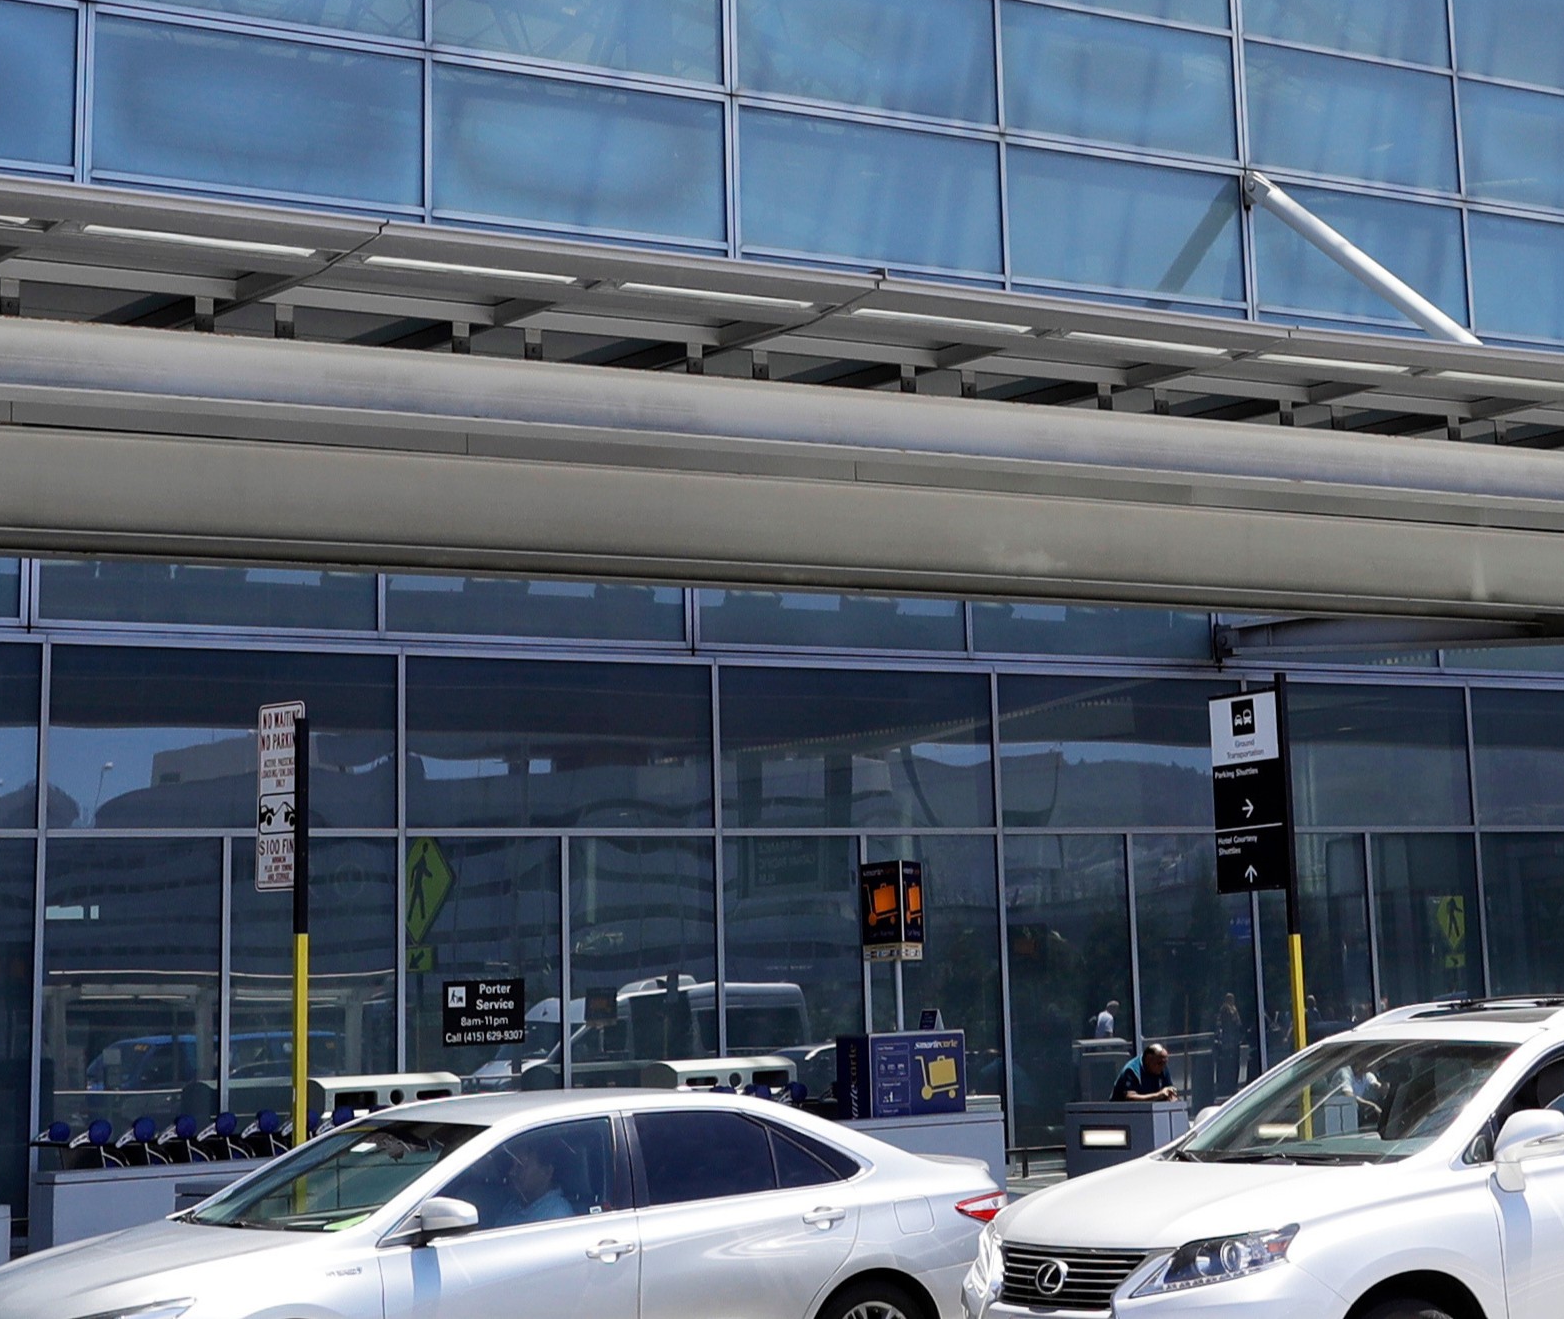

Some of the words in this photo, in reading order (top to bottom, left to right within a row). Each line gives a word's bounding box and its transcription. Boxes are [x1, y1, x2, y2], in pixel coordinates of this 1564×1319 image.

[263, 713, 272, 729] NO
[261, 735, 271, 751] NO
[1215, 769, 1235, 779] Parking
[1236, 767, 1258, 777] Shuttles
[282, 838, 294, 853] FIN
[479, 983, 511, 994] Porter
[476, 998, 514, 1010] Service
[460, 1016, 509, 1027] 8am-11pm
[445, 1032, 462, 1043] Call
[464, 1031, 485, 1043] (415)
[486, 1029, 523, 1041] 629-9307
